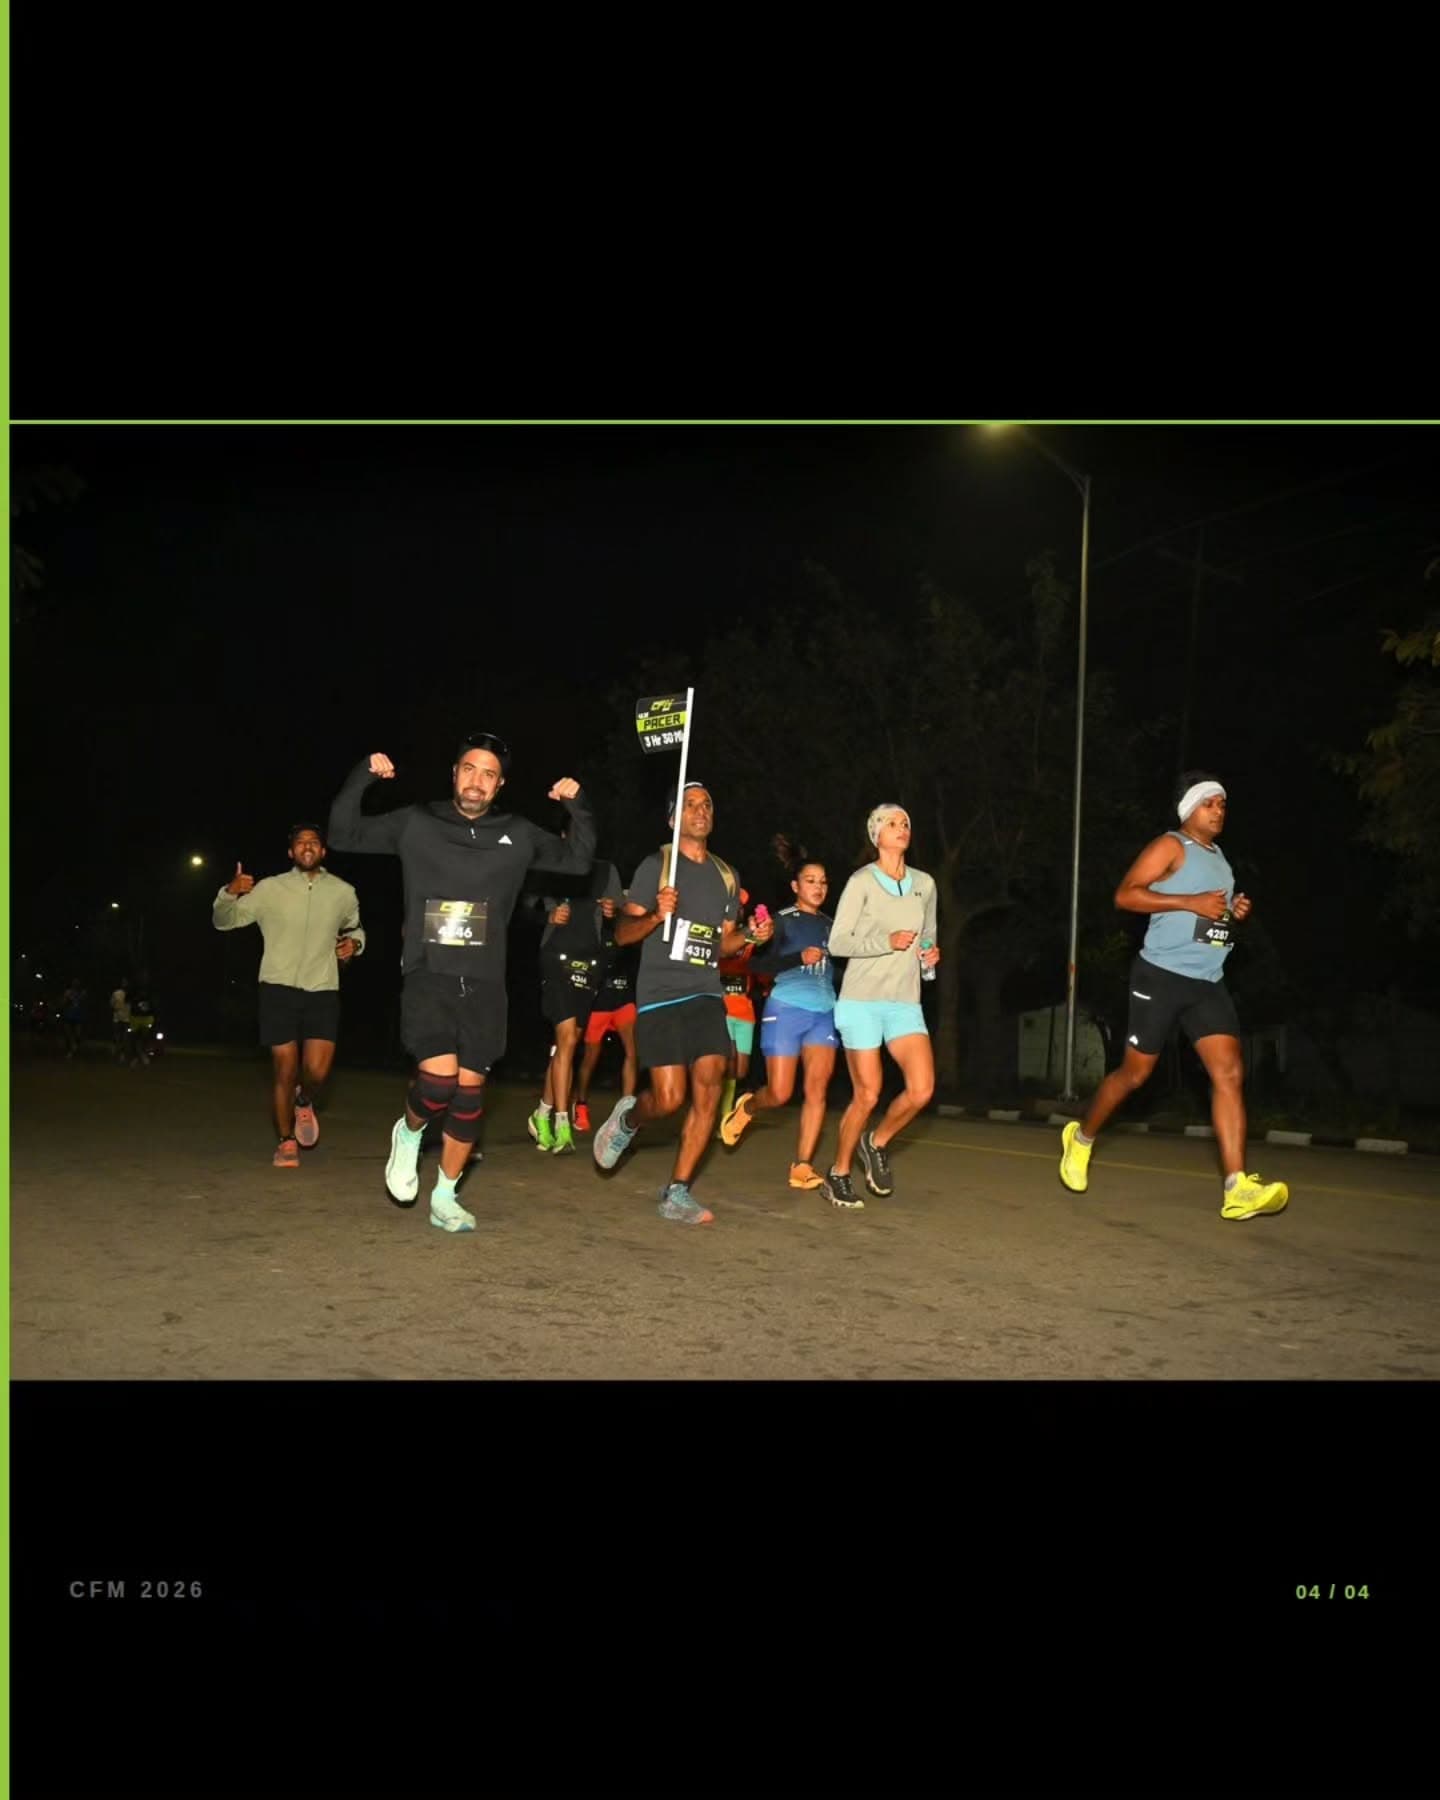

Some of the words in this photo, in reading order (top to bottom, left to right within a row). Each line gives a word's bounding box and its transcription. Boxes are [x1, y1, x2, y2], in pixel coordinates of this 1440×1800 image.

[643, 714, 681, 730] PACER
[644, 735, 652, 748] 3
[651, 734, 661, 747] Hr
[661, 732, 674, 745] 30
[1205, 928, 1229, 940] 4287
[685, 945, 712, 959] 4319
